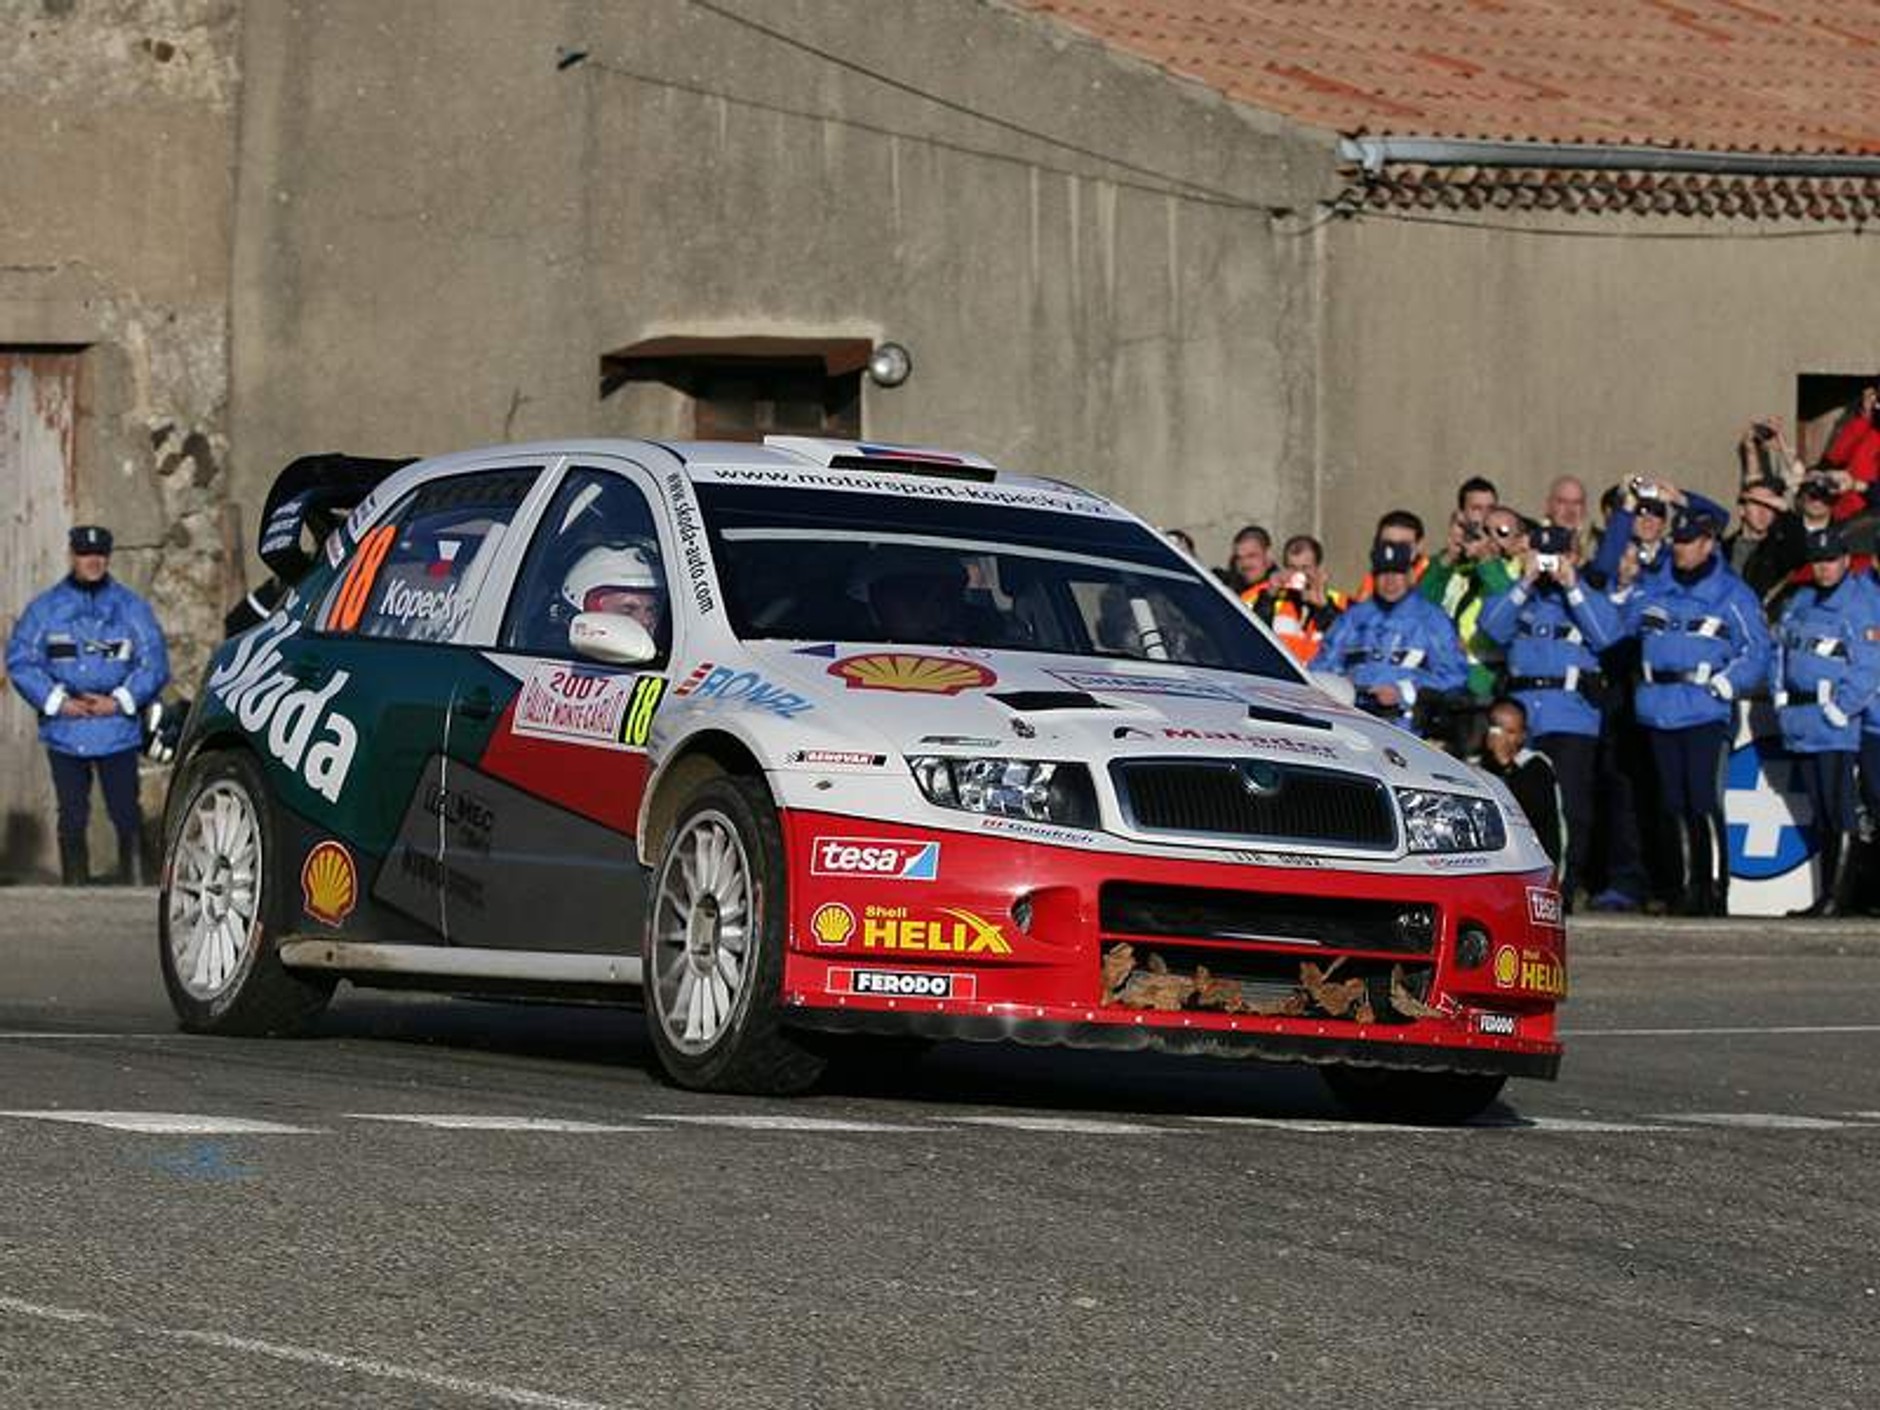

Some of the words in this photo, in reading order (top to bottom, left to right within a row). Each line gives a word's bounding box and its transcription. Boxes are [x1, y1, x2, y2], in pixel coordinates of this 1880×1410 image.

[326, 524, 397, 631] 18
[550, 671, 610, 699] 2007
[624, 677, 662, 745] 18
[822, 841, 900, 871] tesa
[863, 905, 908, 918] Shell
[863, 911, 1013, 954] HELIX
[856, 972, 948, 994] FERODO
